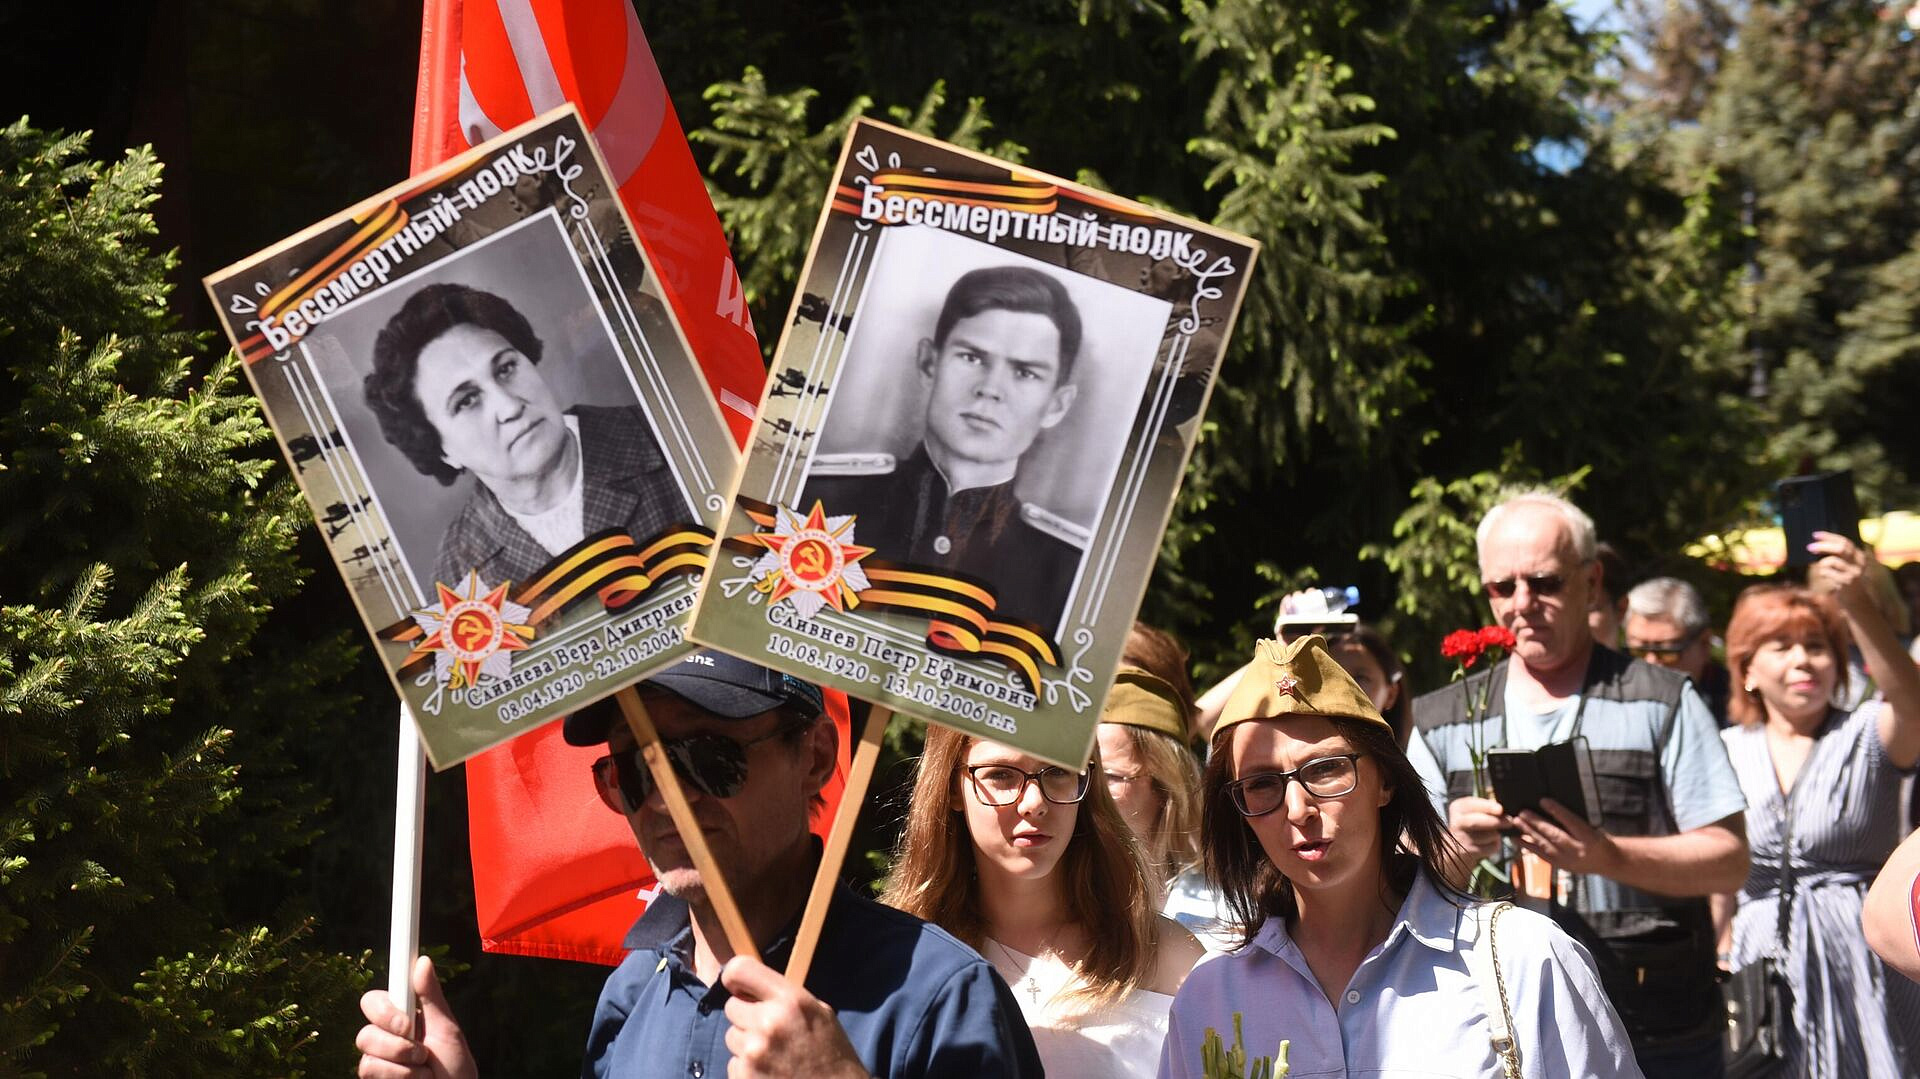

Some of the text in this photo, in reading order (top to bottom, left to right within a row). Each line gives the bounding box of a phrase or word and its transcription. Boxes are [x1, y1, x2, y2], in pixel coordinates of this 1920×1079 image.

[258, 143, 536, 351] Бессмертный полк
[861, 184, 1194, 260] Бессмертный полк
[467, 591, 697, 706] Сливнева Вера Дмитриев
[499, 673, 583, 721] 08.04.1920
[596, 632, 681, 680] 22.10.2004
[768, 605, 1036, 710] Сливнев Петр Ефимович
[768, 635, 867, 682] 10.08.1920
[884, 674, 984, 721] 13.10.2006
[989, 713, 1016, 733] г.г.
